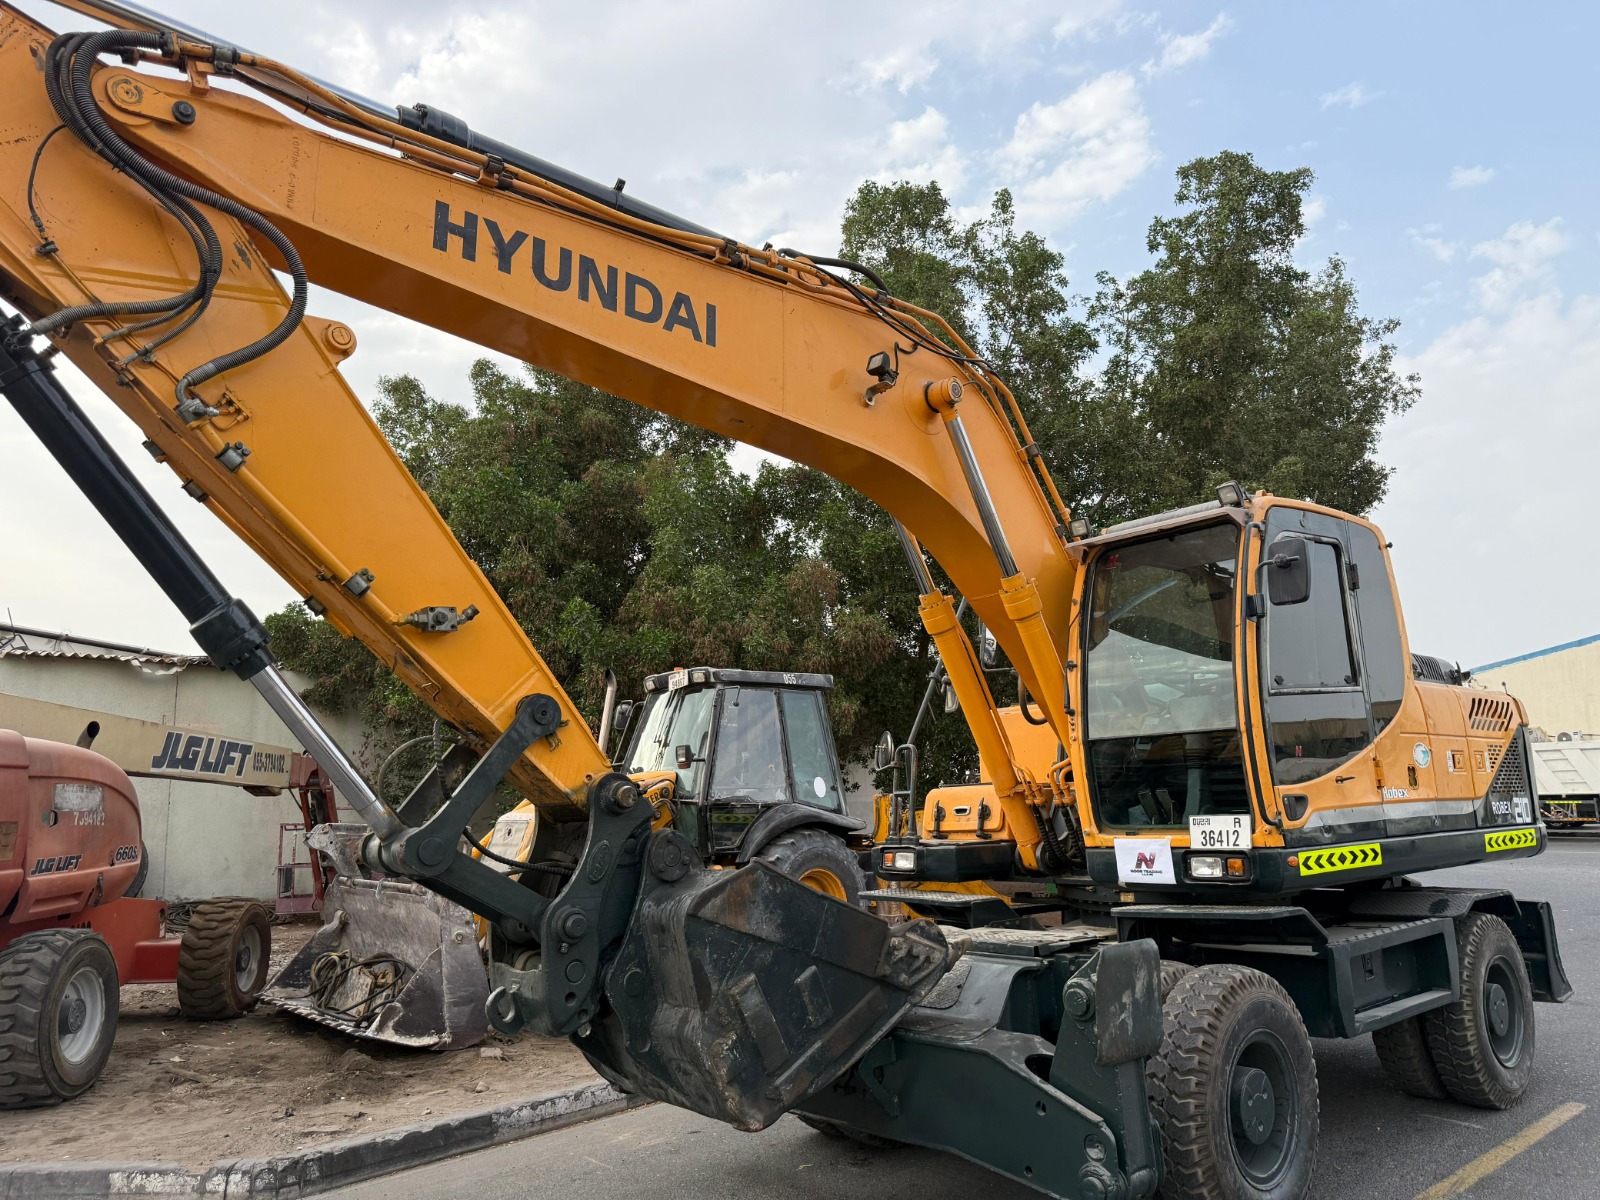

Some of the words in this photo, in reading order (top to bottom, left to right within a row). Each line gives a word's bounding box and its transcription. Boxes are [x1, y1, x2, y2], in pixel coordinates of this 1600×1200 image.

[432, 200, 717, 348] HYUNDAI
[151, 731, 206, 771] JLG
[198, 737, 254, 777] LIFT
[1491, 801, 1512, 815] ROBEX
[1513, 797, 1532, 824] 210
[1233, 817, 1242, 828] R
[1200, 829, 1240, 847] 36412
[30, 858, 57, 875] JLG
[55, 855, 83, 872] LIFT
